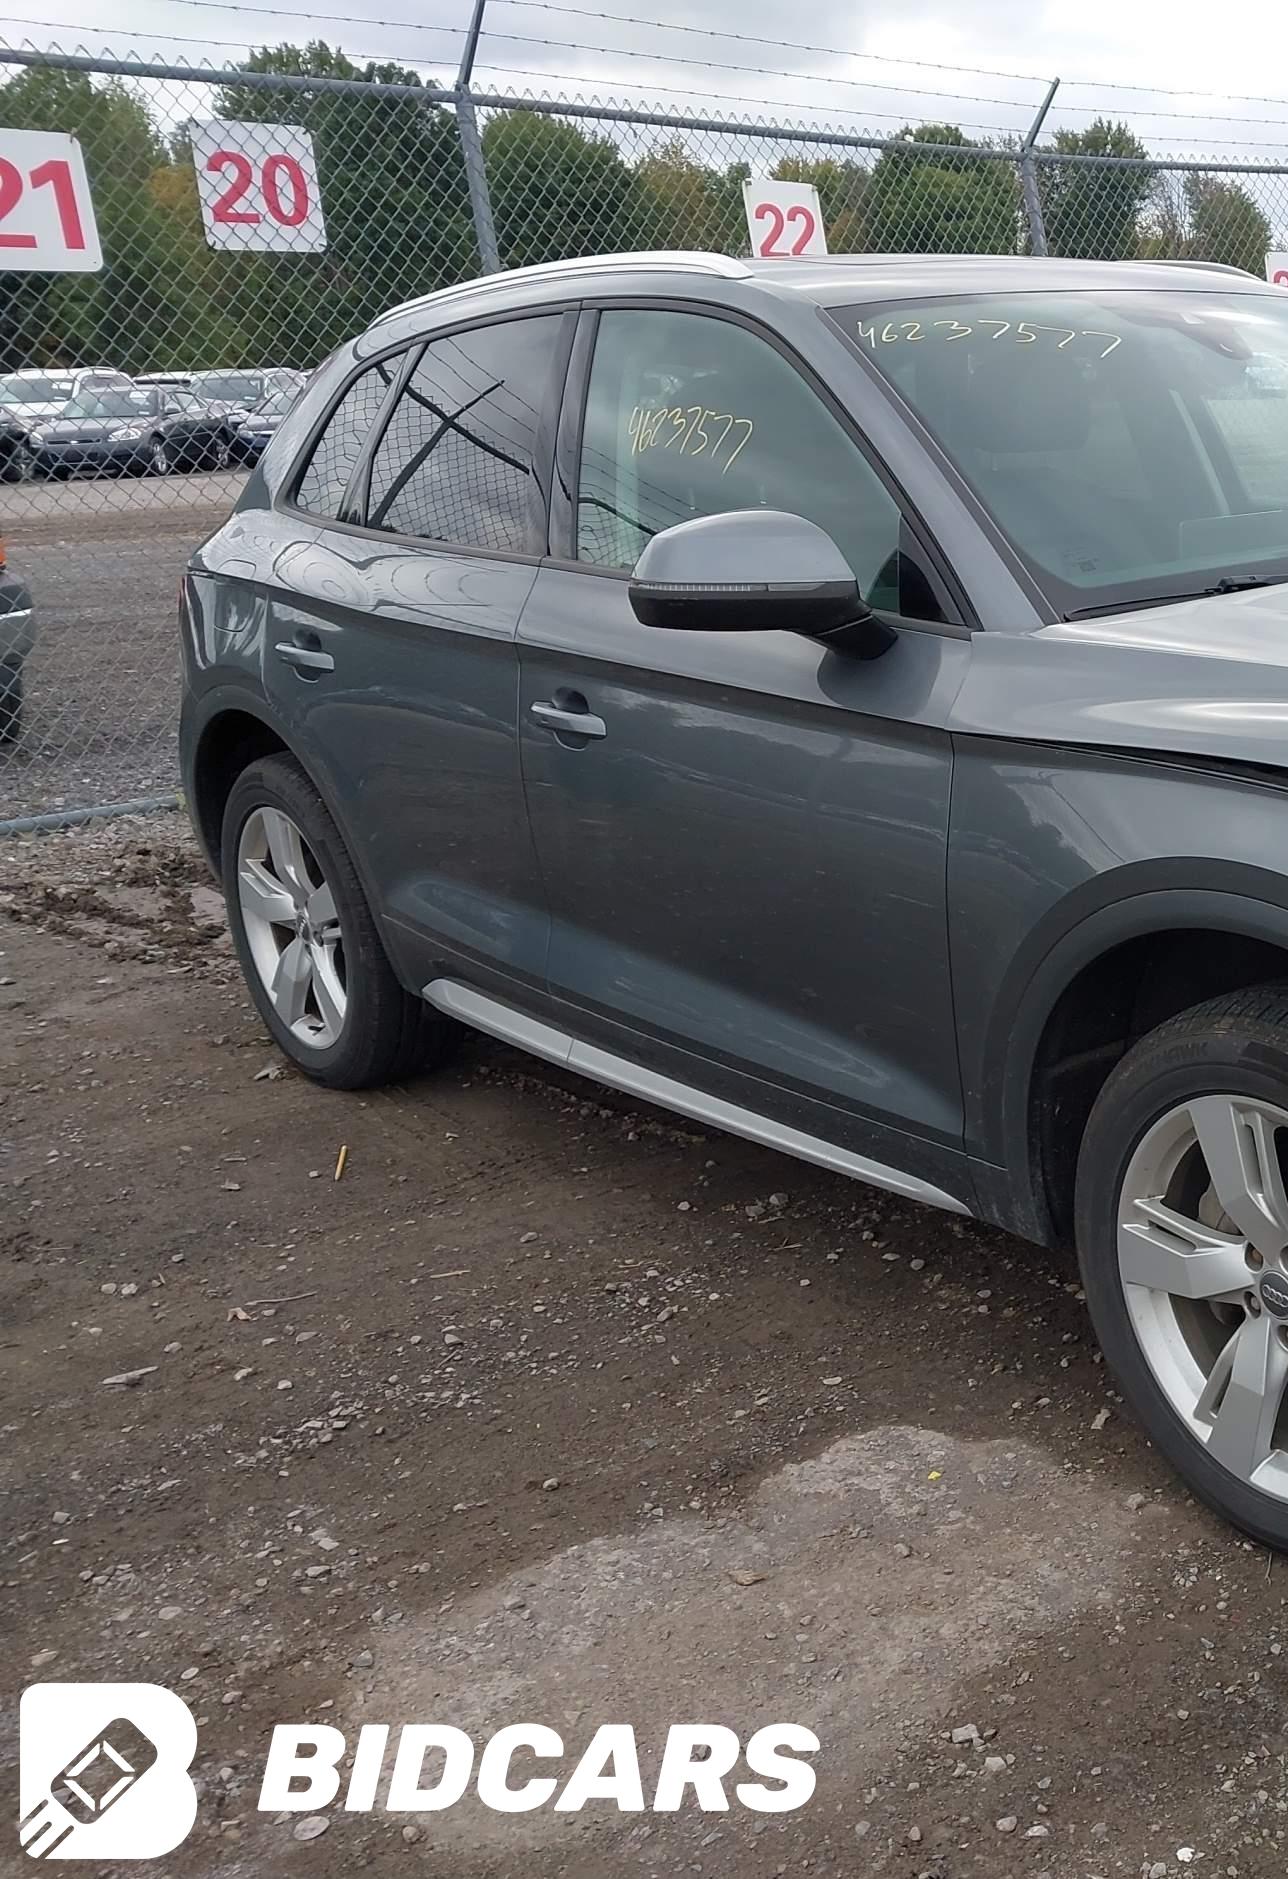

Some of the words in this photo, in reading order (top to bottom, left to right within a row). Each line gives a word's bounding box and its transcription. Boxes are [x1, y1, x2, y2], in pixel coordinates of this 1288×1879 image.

[206, 150, 309, 227] 20
[754, 202, 816, 258] 22
[856, 320, 1122, 359] 46237577
[628, 405, 753, 475] 46237577
